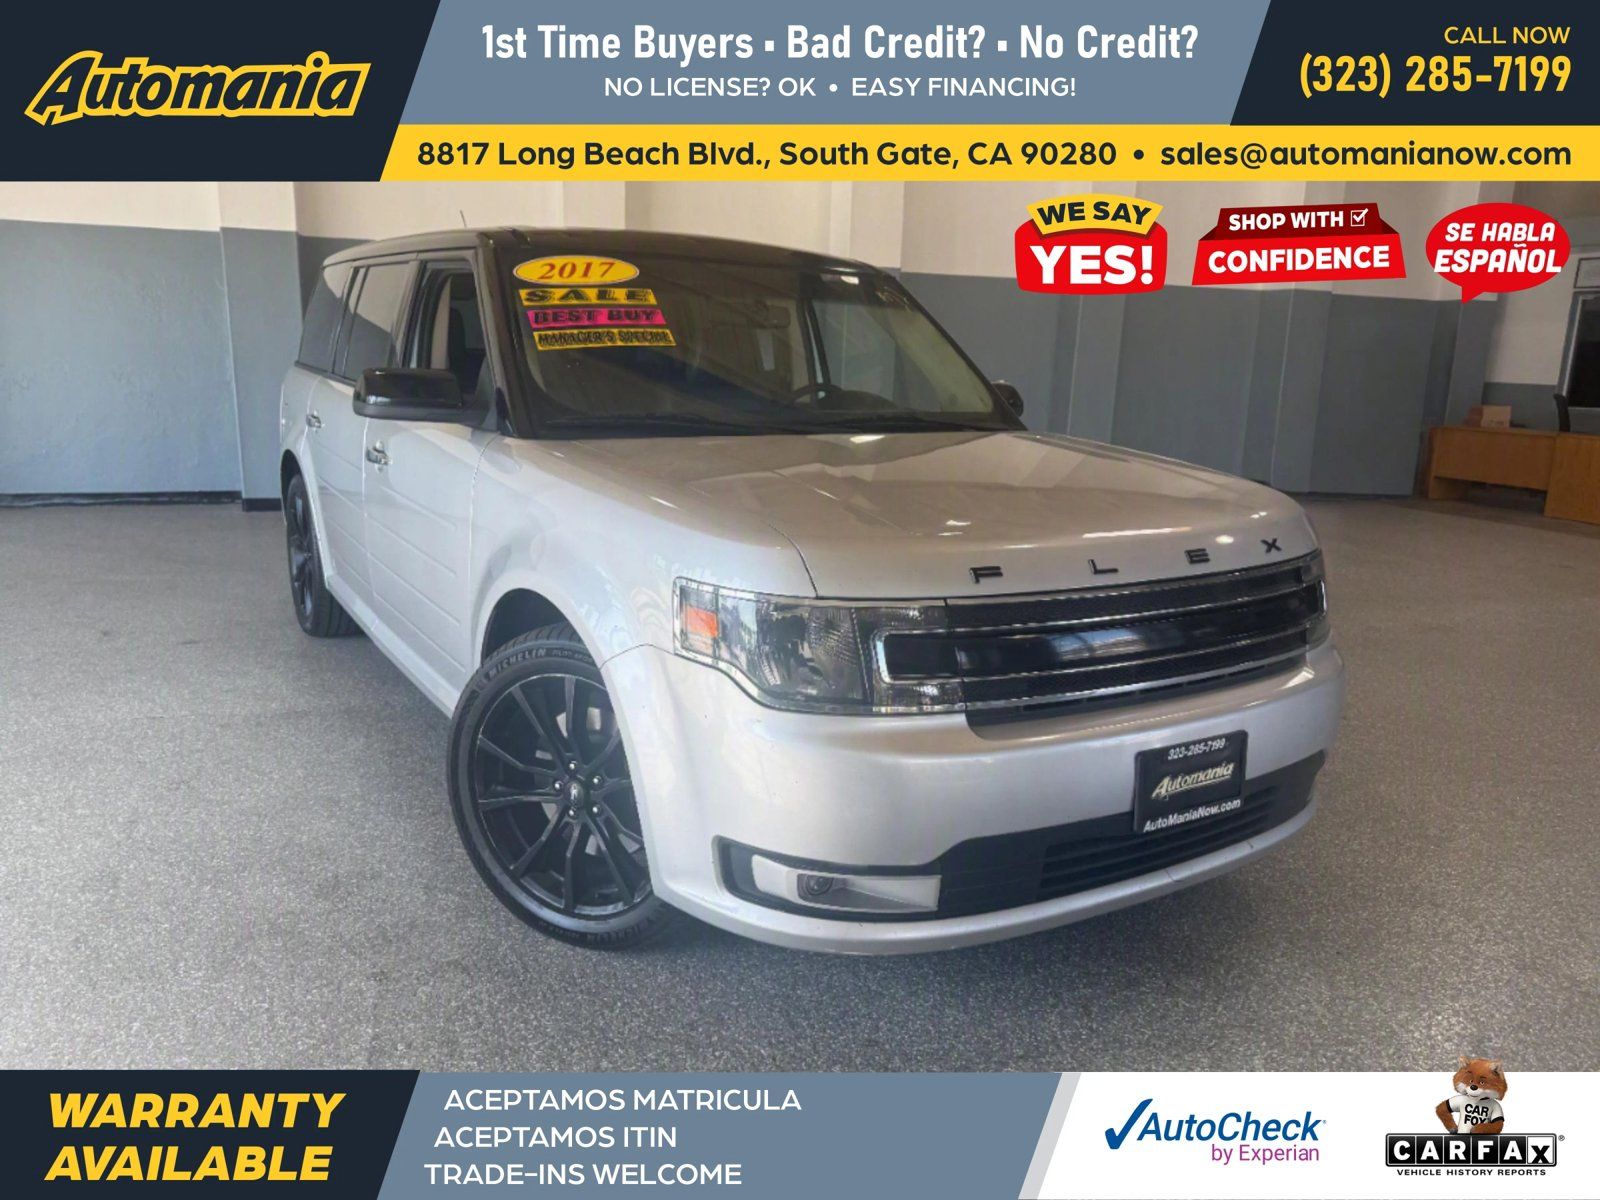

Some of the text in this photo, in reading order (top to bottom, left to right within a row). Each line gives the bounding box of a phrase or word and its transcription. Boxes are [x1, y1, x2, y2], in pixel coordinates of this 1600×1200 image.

[538, 261, 616, 280] 2017
[525, 289, 652, 303] SALE
[533, 308, 657, 325] BEST BUY
[488, 648, 546, 680] MICHELIN
[1168, 738, 1226, 760] 323-285-7199
[1152, 761, 1235, 800] Automania
[1143, 799, 1241, 833] AutoManiaNow.com
